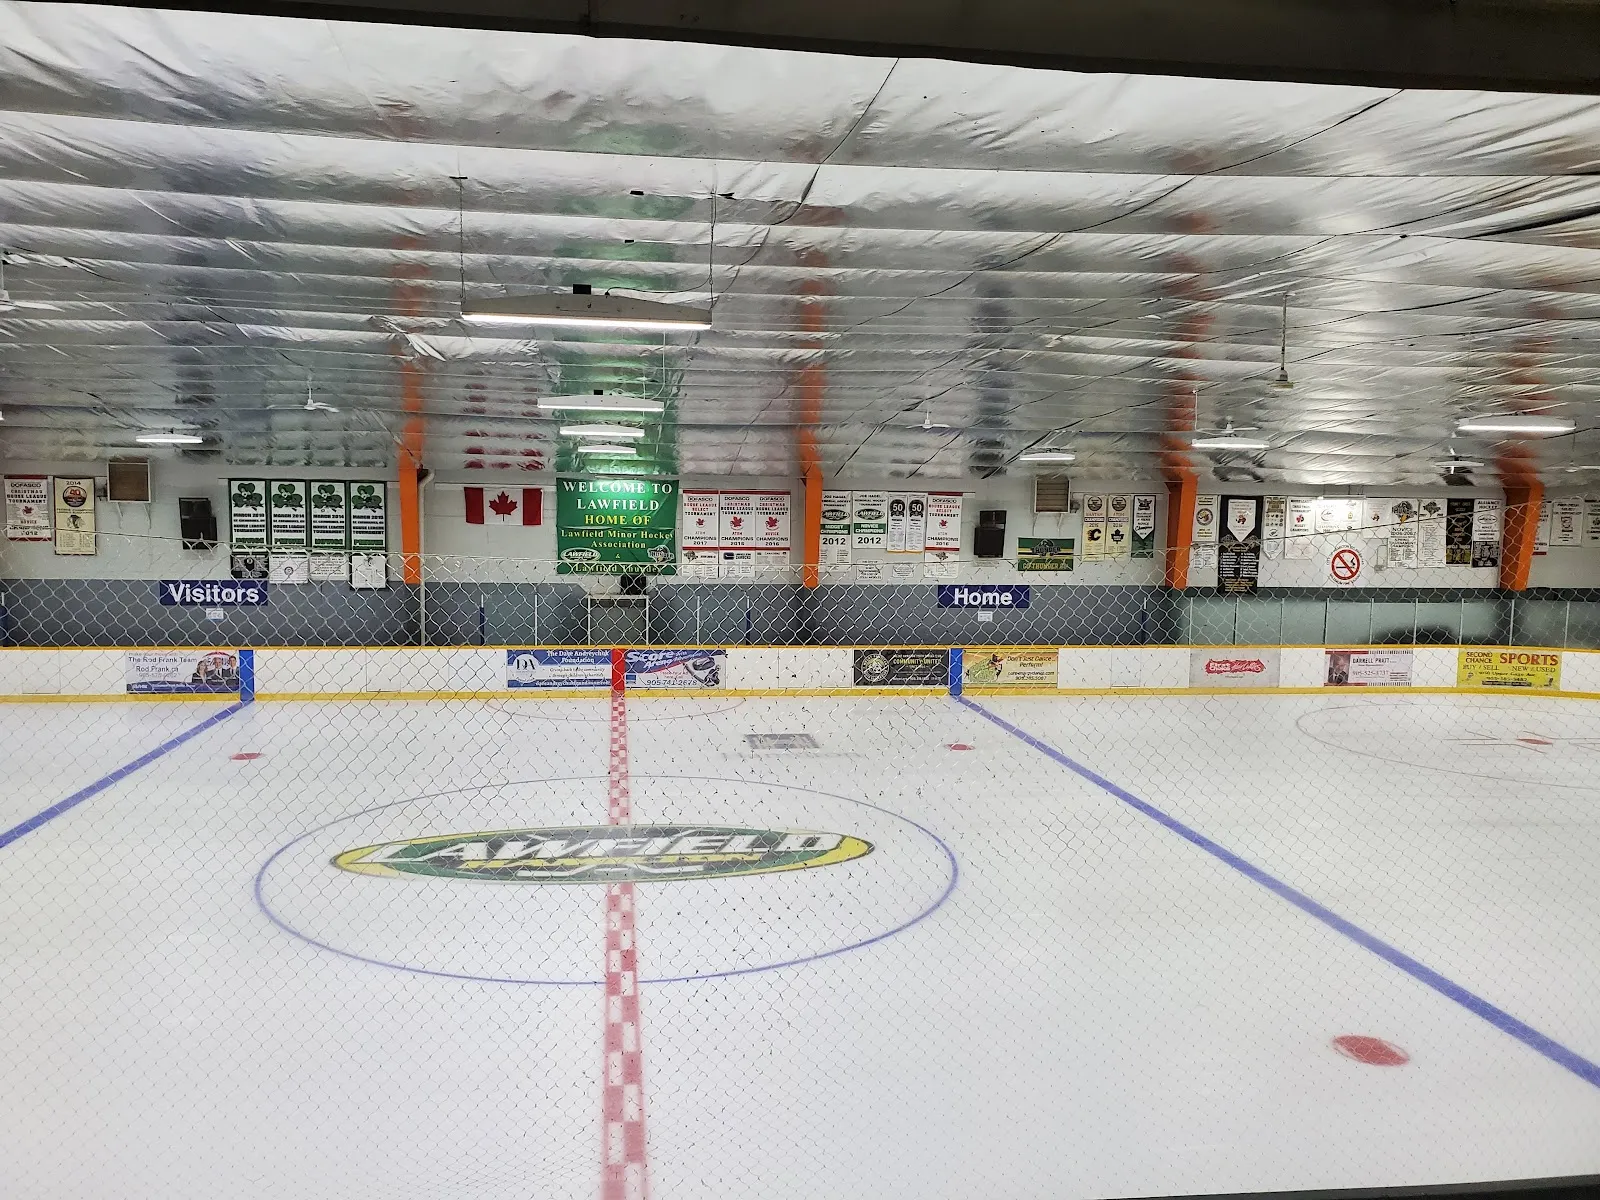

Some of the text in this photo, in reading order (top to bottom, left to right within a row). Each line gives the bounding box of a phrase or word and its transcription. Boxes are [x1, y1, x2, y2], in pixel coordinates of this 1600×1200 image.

[563, 481, 672, 494] WELCOME TO
[577, 498, 660, 511] LAWFIELD
[893, 503, 903, 511] 50
[912, 503, 922, 511] 50
[585, 514, 652, 525] HOME OF
[562, 530, 604, 538] Lawfield
[608, 530, 637, 538] Minor
[591, 540, 646, 549] Association
[575, 564, 618, 573] Lawfield
[169, 584, 259, 602] Visitors
[954, 588, 1012, 605] Home
[626, 652, 674, 662] Score
[1500, 653, 1558, 666] SPORTS
[643, 658, 673, 668] Arena
[350, 829, 842, 862] LAWFIELD
